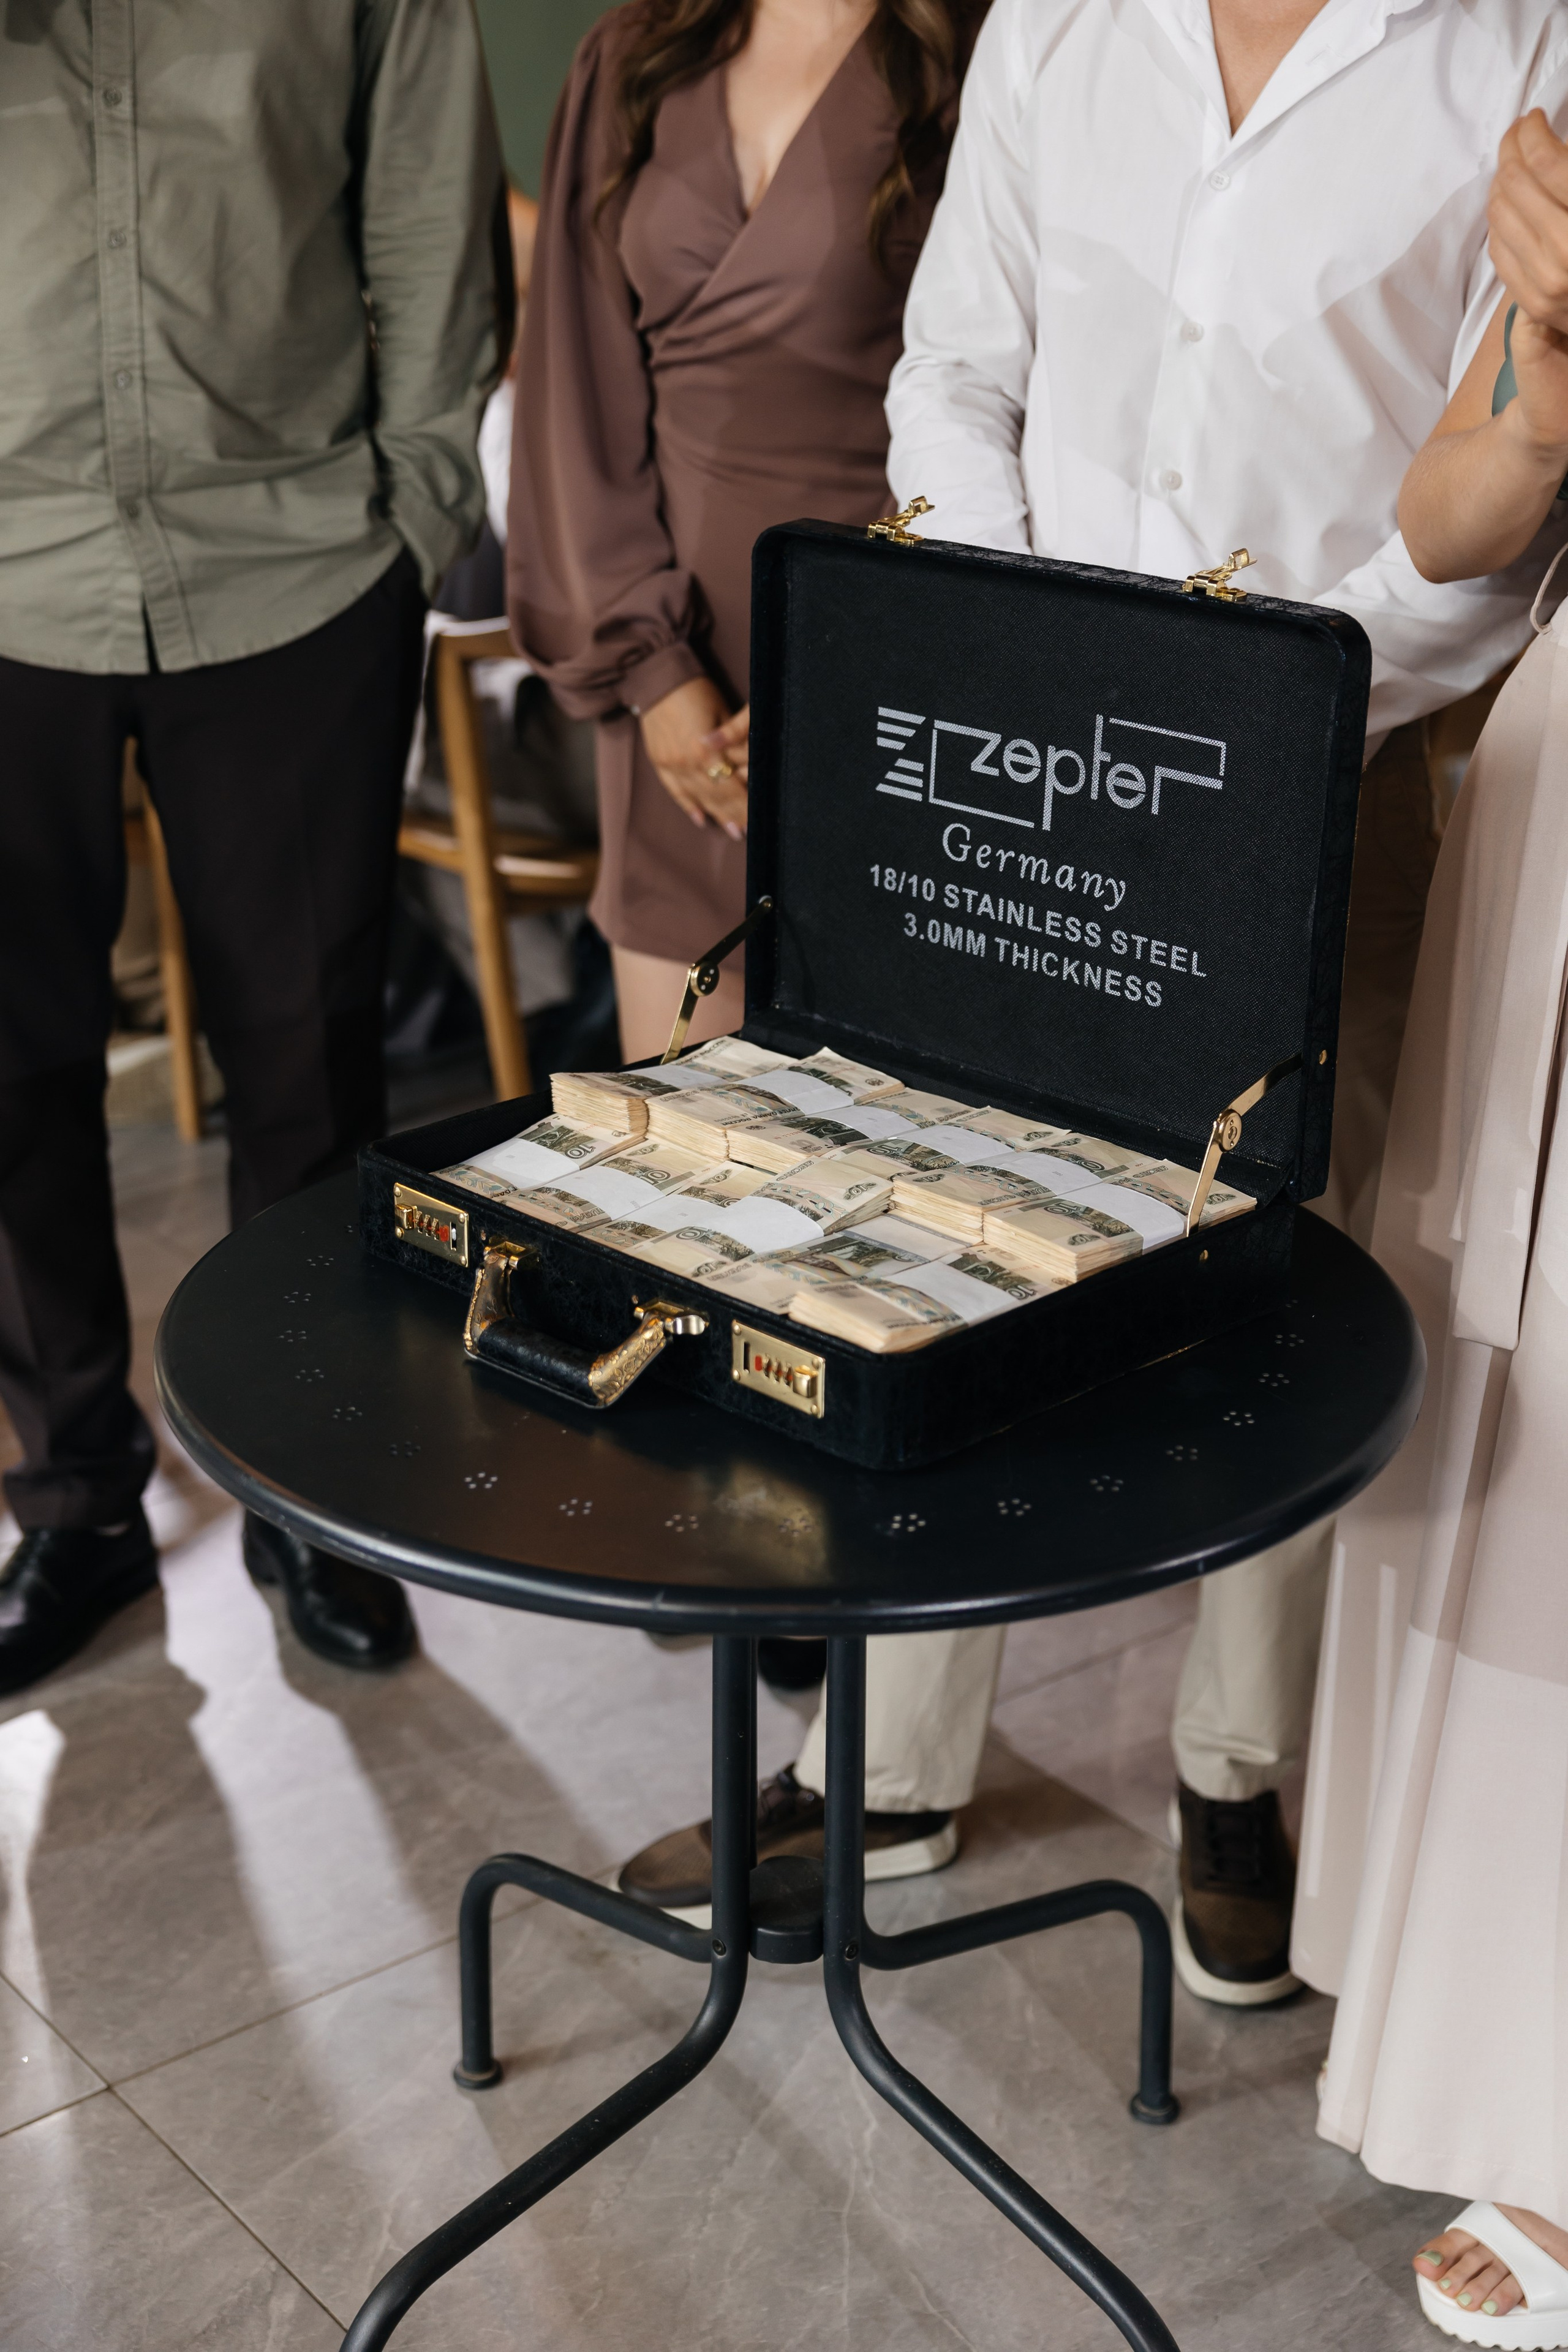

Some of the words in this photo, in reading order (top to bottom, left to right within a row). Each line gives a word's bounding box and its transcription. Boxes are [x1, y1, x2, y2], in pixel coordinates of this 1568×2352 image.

[929, 713, 1227, 832] zepter
[941, 822, 1127, 912] Germany
[869, 864, 937, 902] 18/10
[942, 883, 1103, 948] STAINLESS
[1110, 929, 1208, 979] STEEL
[903, 912, 987, 958] 3.0MM
[993, 936, 1164, 1008] THICKNESS
[722, 1117, 752, 1126] РОССИИ
[564, 1144, 597, 1159] 10
[866, 1145, 903, 1156] 10
[642, 1169, 671, 1186] 10
[1044, 1202, 1082, 1215] 10
[676, 1226, 712, 1240] 10
[1006, 1285, 1037, 1300] 10
